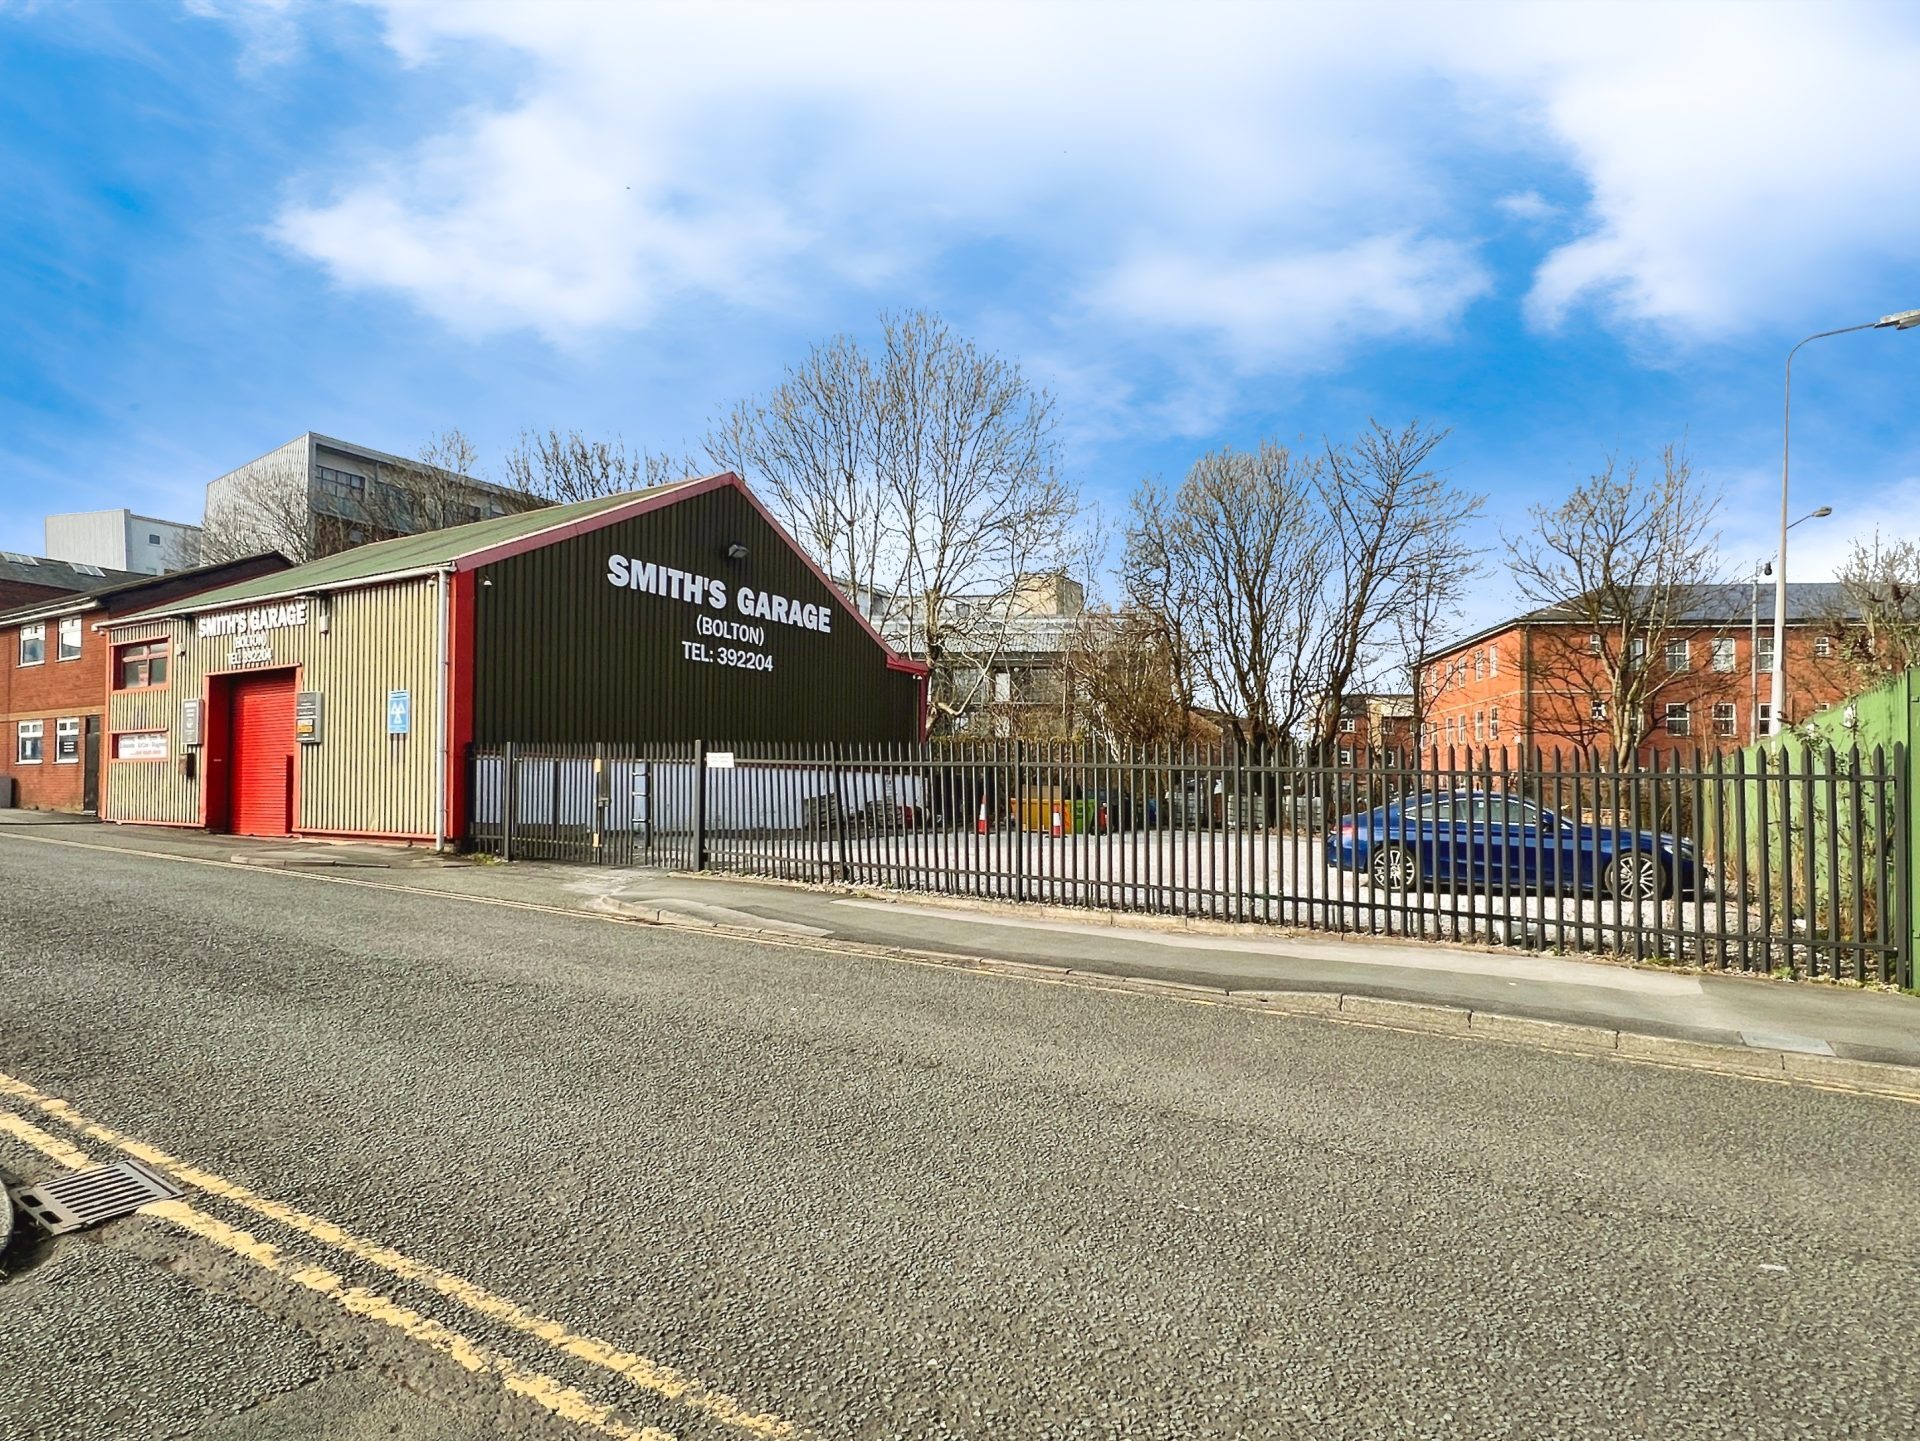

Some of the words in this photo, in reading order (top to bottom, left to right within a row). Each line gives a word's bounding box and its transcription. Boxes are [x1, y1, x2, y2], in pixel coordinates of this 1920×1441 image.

[607, 554, 727, 609] SMITH'S
[737, 586, 831, 633] GARAGE
[199, 613, 247, 638] SMITH'S
[250, 604, 307, 631] GARAGE
[696, 614, 764, 646] (BOLTON)
[681, 640, 713, 662] TEL:
[717, 646, 773, 671] 392204
